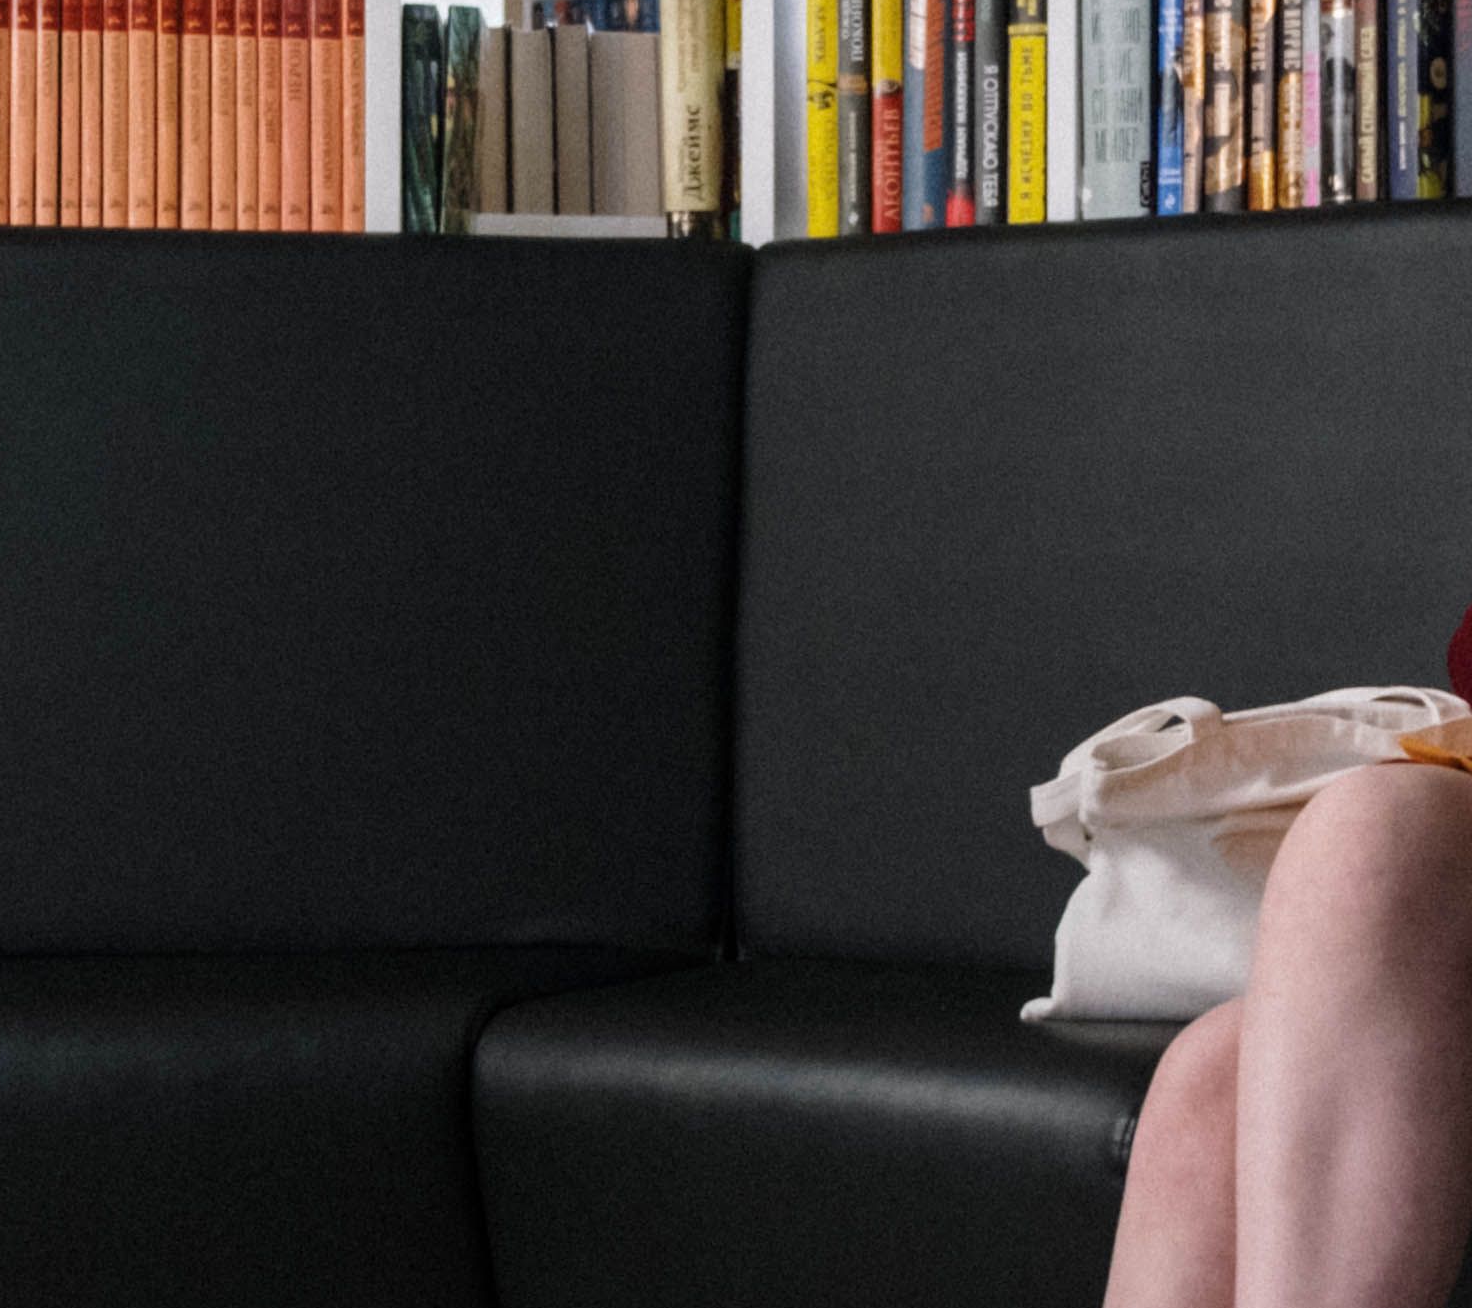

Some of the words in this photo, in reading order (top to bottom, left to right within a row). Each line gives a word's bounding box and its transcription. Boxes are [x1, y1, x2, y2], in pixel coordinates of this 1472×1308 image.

[1021, 46, 1034, 85] ТЬМЕ
[983, 77, 998, 170] ОТПУСКАЮ
[1021, 91, 1034, 112] ВО
[685, 104, 703, 201] Джеймс
[883, 108, 900, 222] ЛЕОНТЬЕВ
[1021, 119, 1034, 184] ИСЧЕЗНУ
[983, 172, 998, 208] ТЕБЯ
